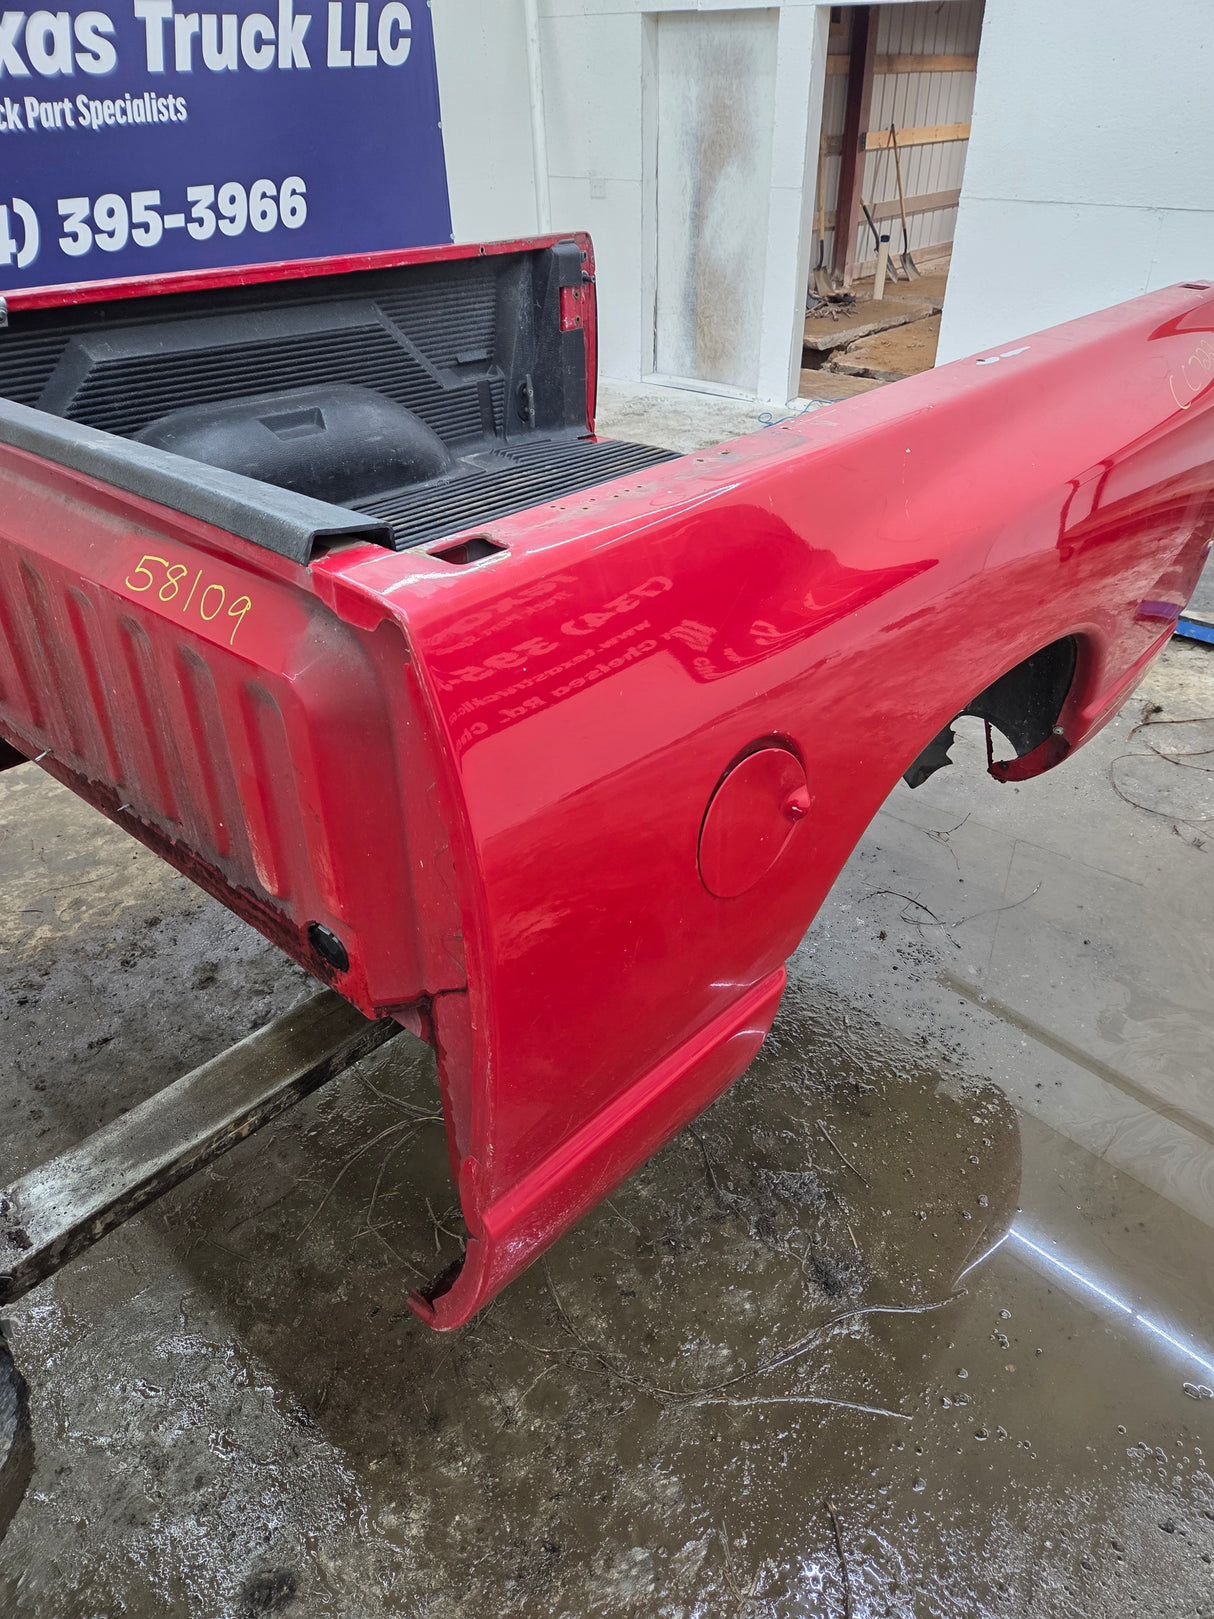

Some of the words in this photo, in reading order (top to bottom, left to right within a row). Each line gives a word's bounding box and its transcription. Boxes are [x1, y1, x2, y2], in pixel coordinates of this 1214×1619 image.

[134, 0, 312, 72] Truck
[327, 1, 412, 67] LLC
[24, 96, 75, 129] Part
[75, 92, 188, 130] Specialists
[57, 176, 307, 256] 395-3966
[125, 555, 252, 645] 58109
